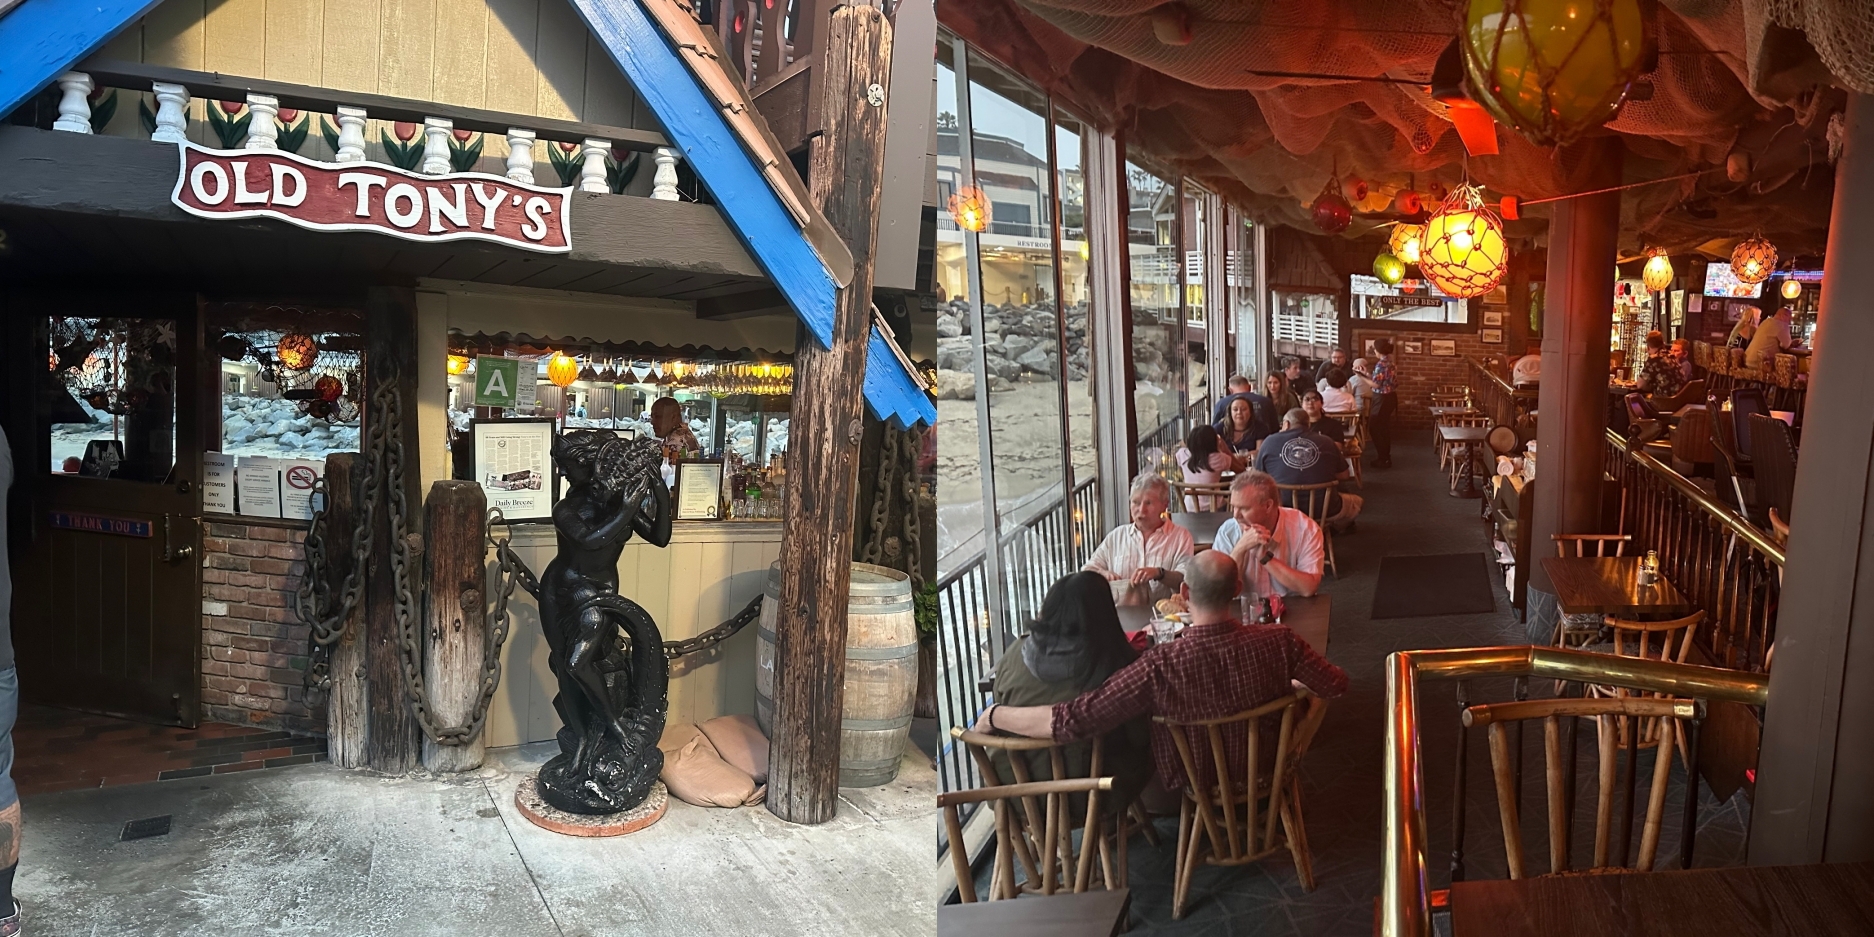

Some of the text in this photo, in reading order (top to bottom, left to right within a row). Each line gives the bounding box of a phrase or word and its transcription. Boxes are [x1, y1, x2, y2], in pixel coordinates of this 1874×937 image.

[190, 160, 552, 241] OLD TONY'S
[1017, 240, 1051, 248] RESTROO
[1382, 296, 1402, 304] ONLY
[483, 369, 509, 397] A
[495, 499, 511, 508] Daily
[67, 514, 130, 532] THANK YOU
